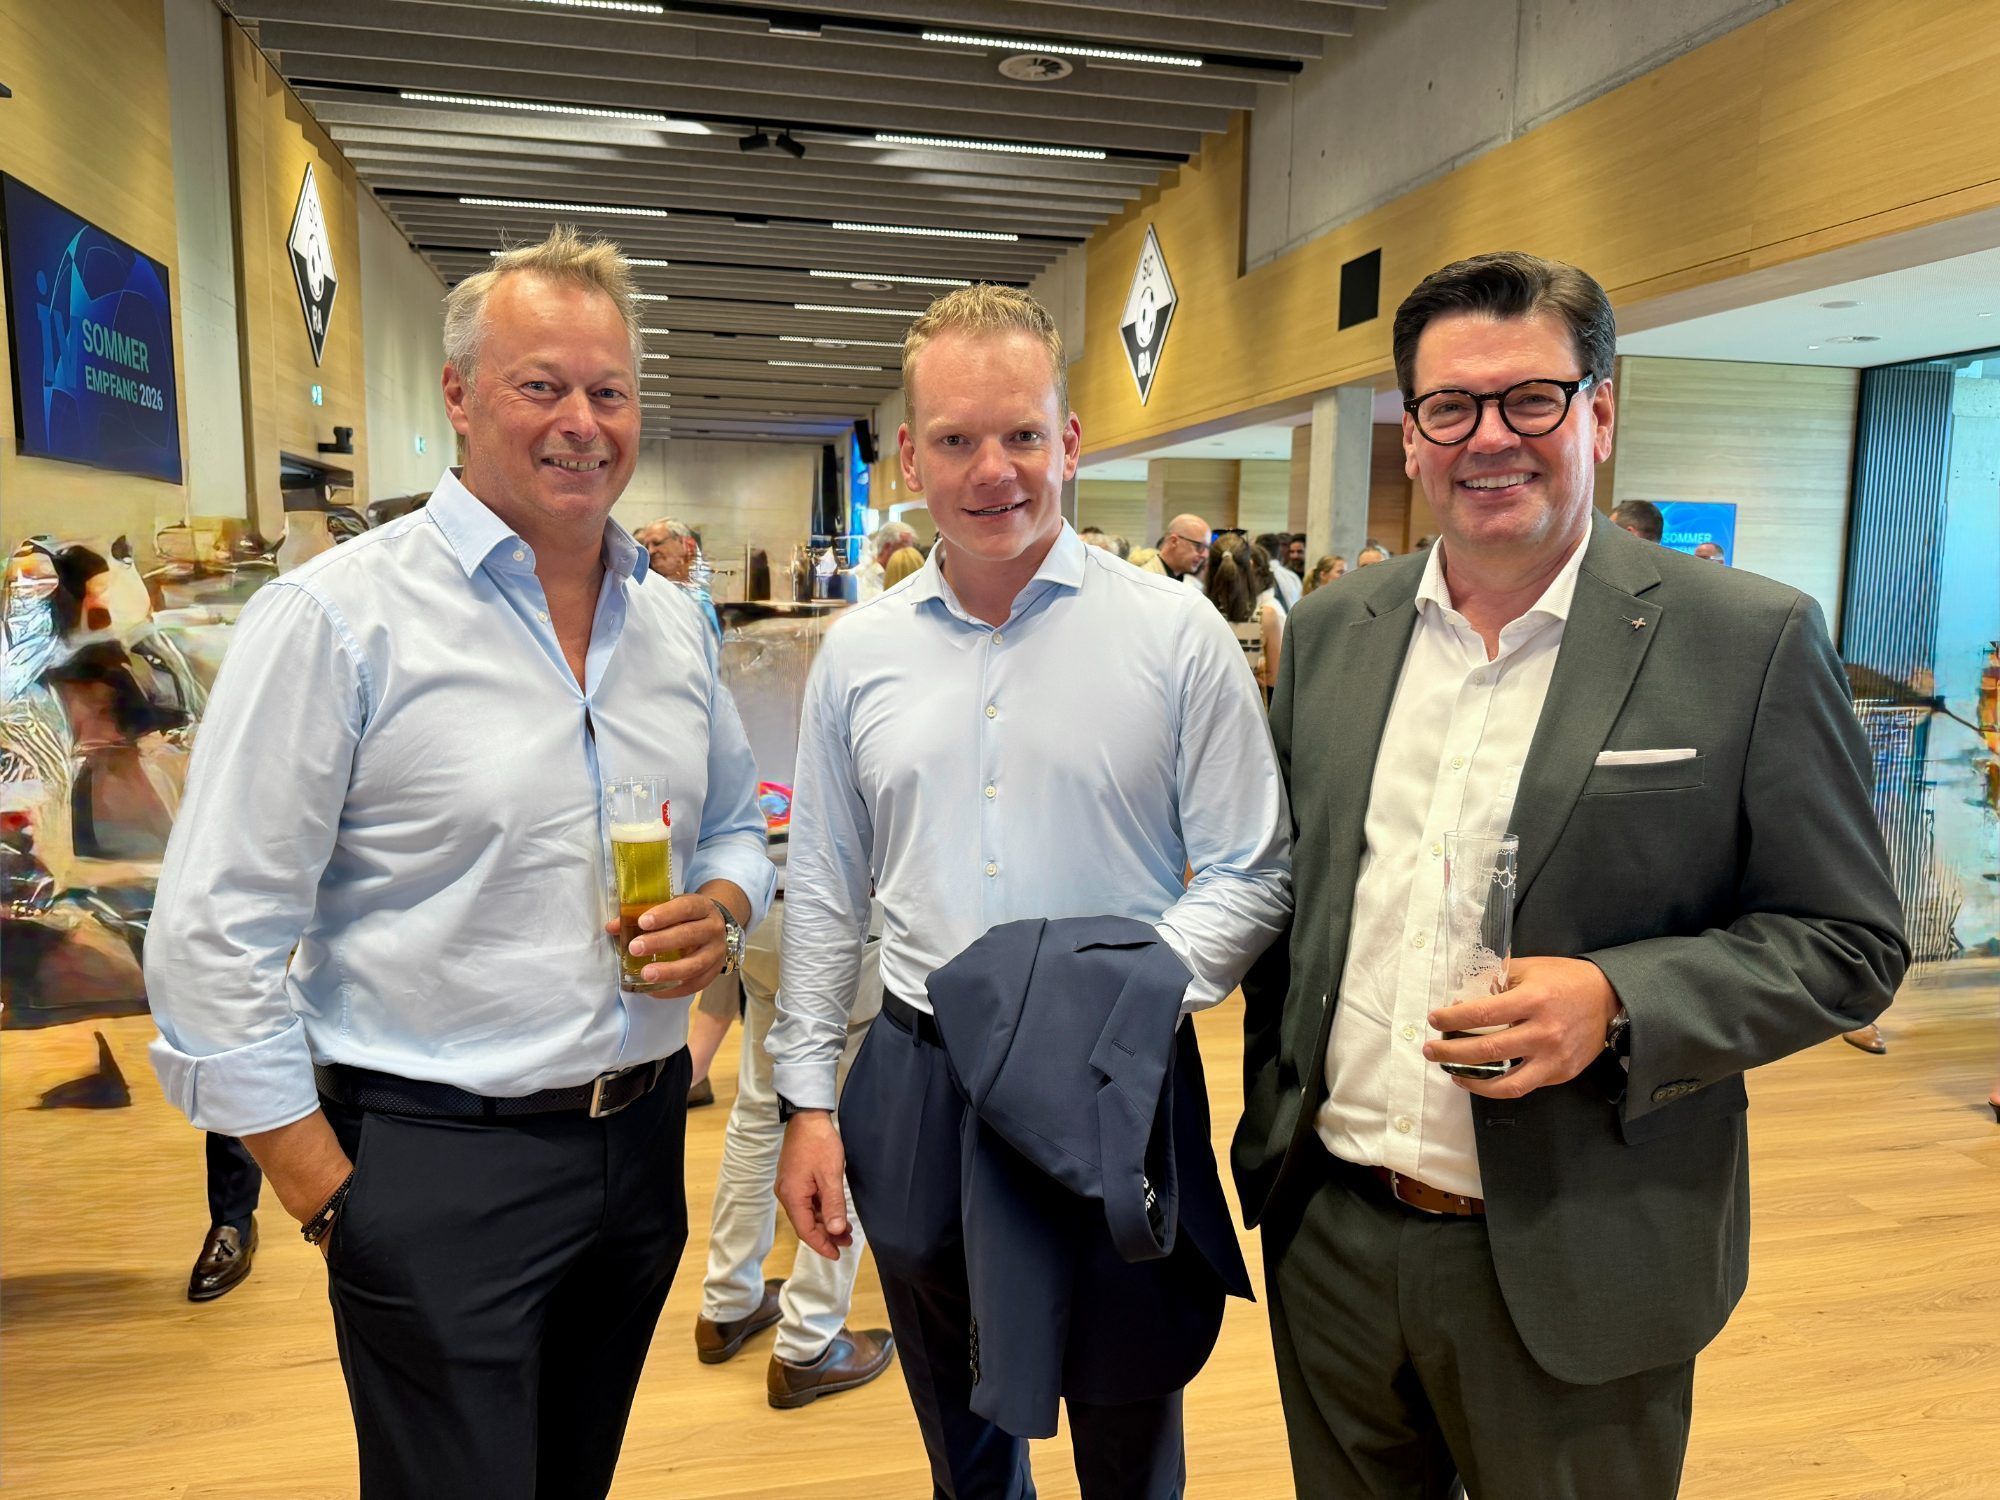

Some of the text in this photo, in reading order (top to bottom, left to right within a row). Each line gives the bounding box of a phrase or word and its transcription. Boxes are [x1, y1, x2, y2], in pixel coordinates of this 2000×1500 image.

[311, 304, 324, 336] RA
[82, 318, 149, 374] SOMMER
[85, 365, 163, 411] EMPFANG 2026
[1663, 532, 1712, 544] SOMMER
